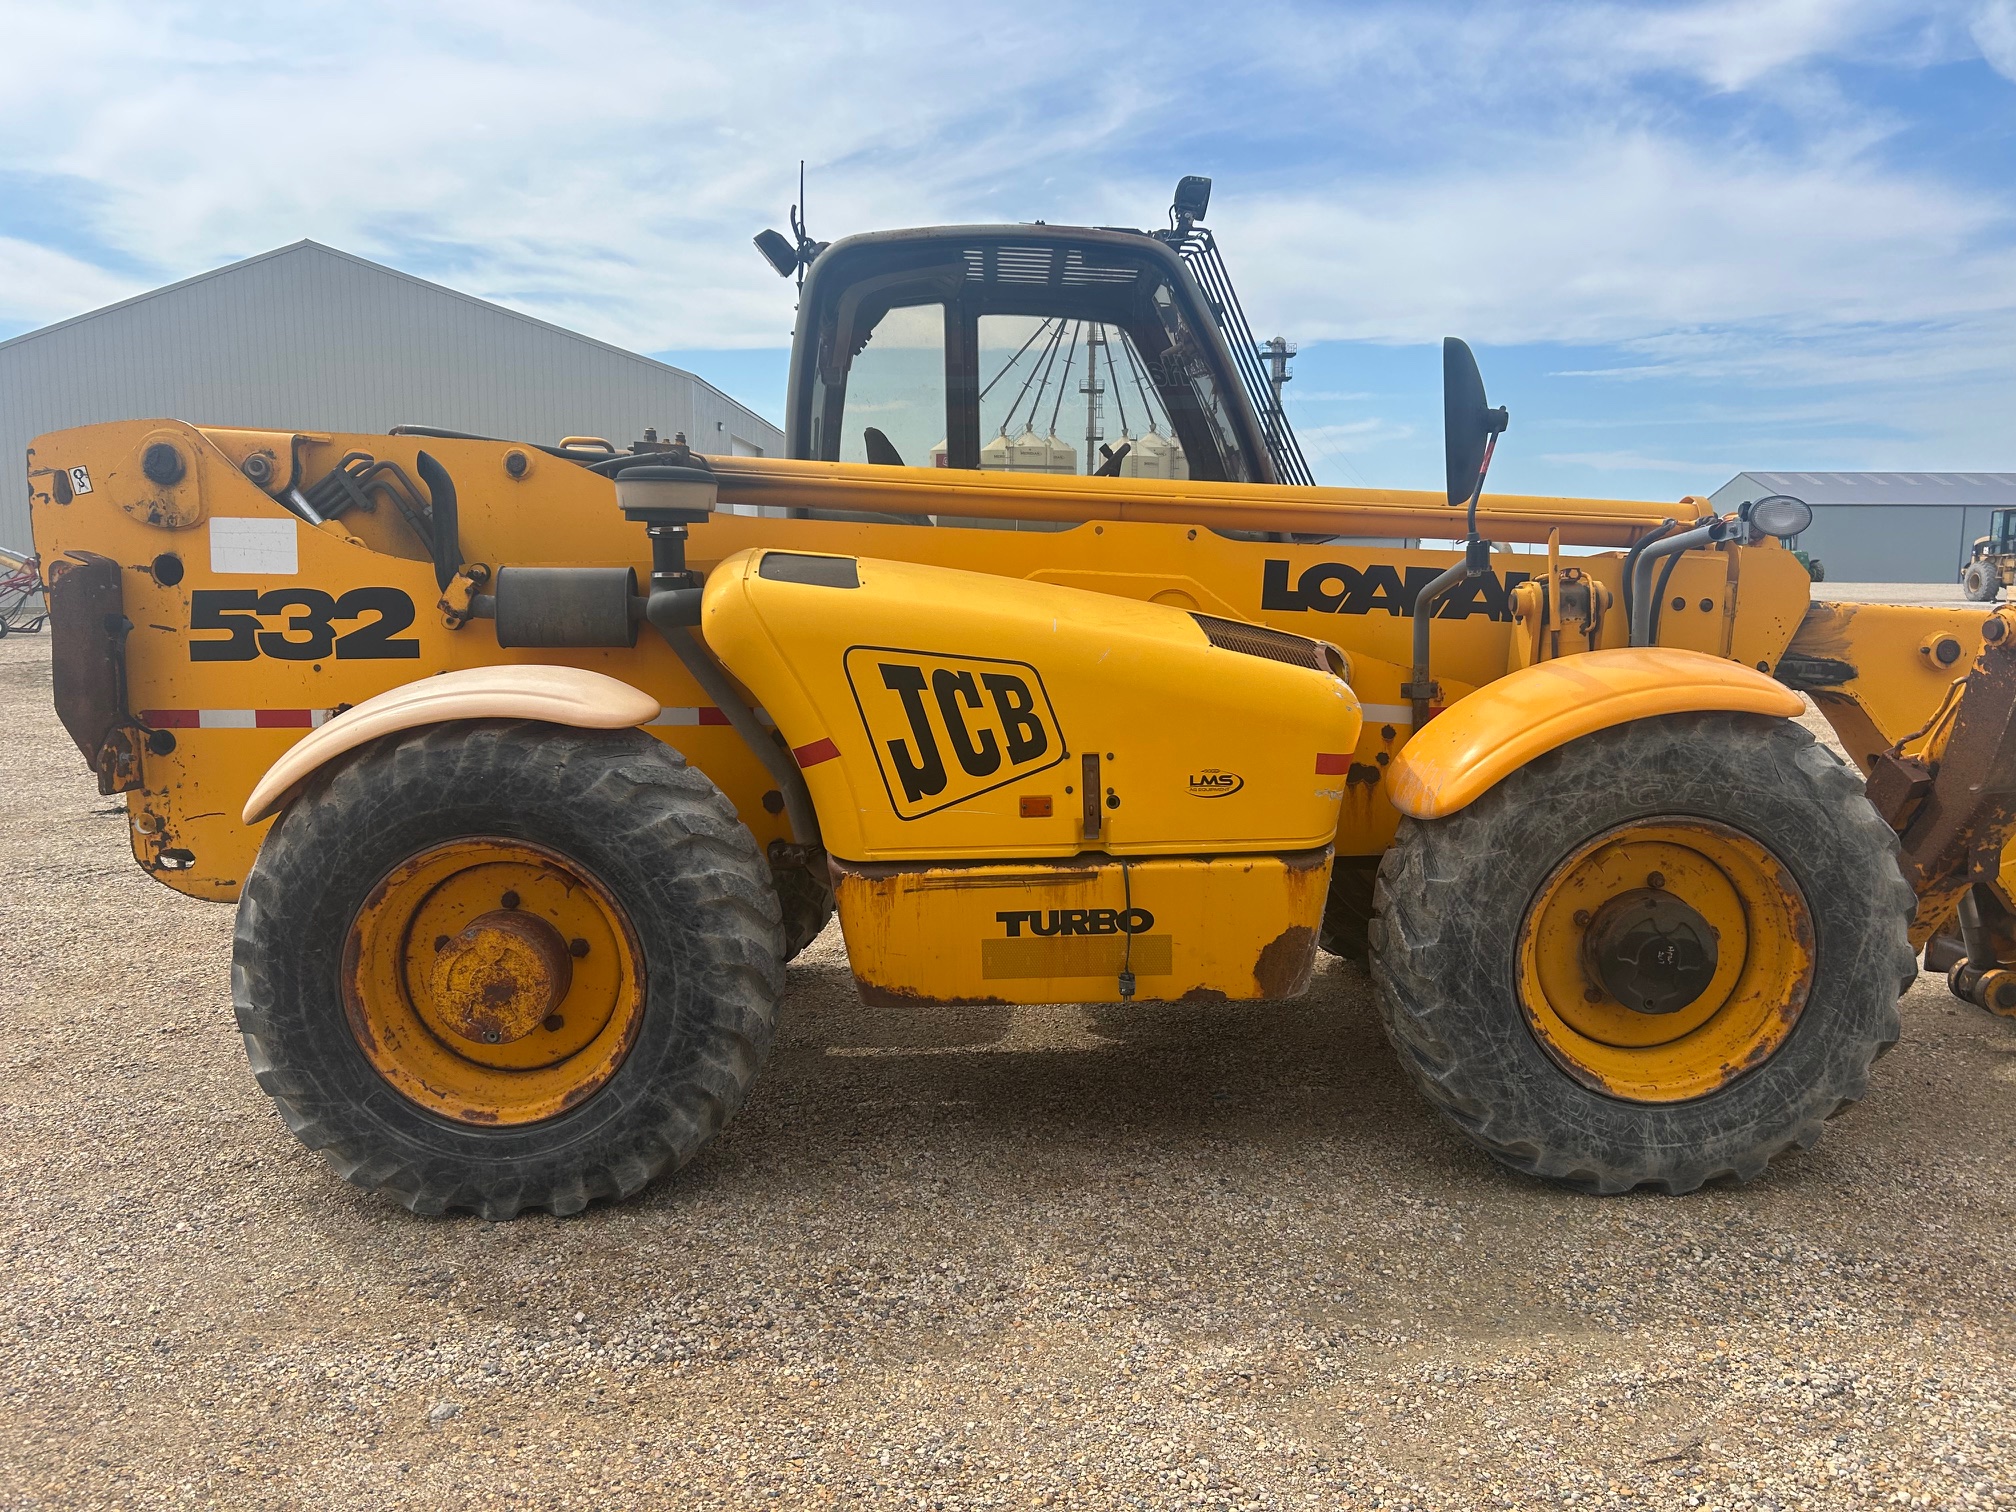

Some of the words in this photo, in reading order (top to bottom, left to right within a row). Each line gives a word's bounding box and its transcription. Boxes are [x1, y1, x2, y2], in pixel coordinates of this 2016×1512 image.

[189, 587, 420, 661] 532
[877, 663, 1047, 803] JCB
[1189, 775, 1233, 786] LMS
[996, 908, 1154, 937] TURBO
